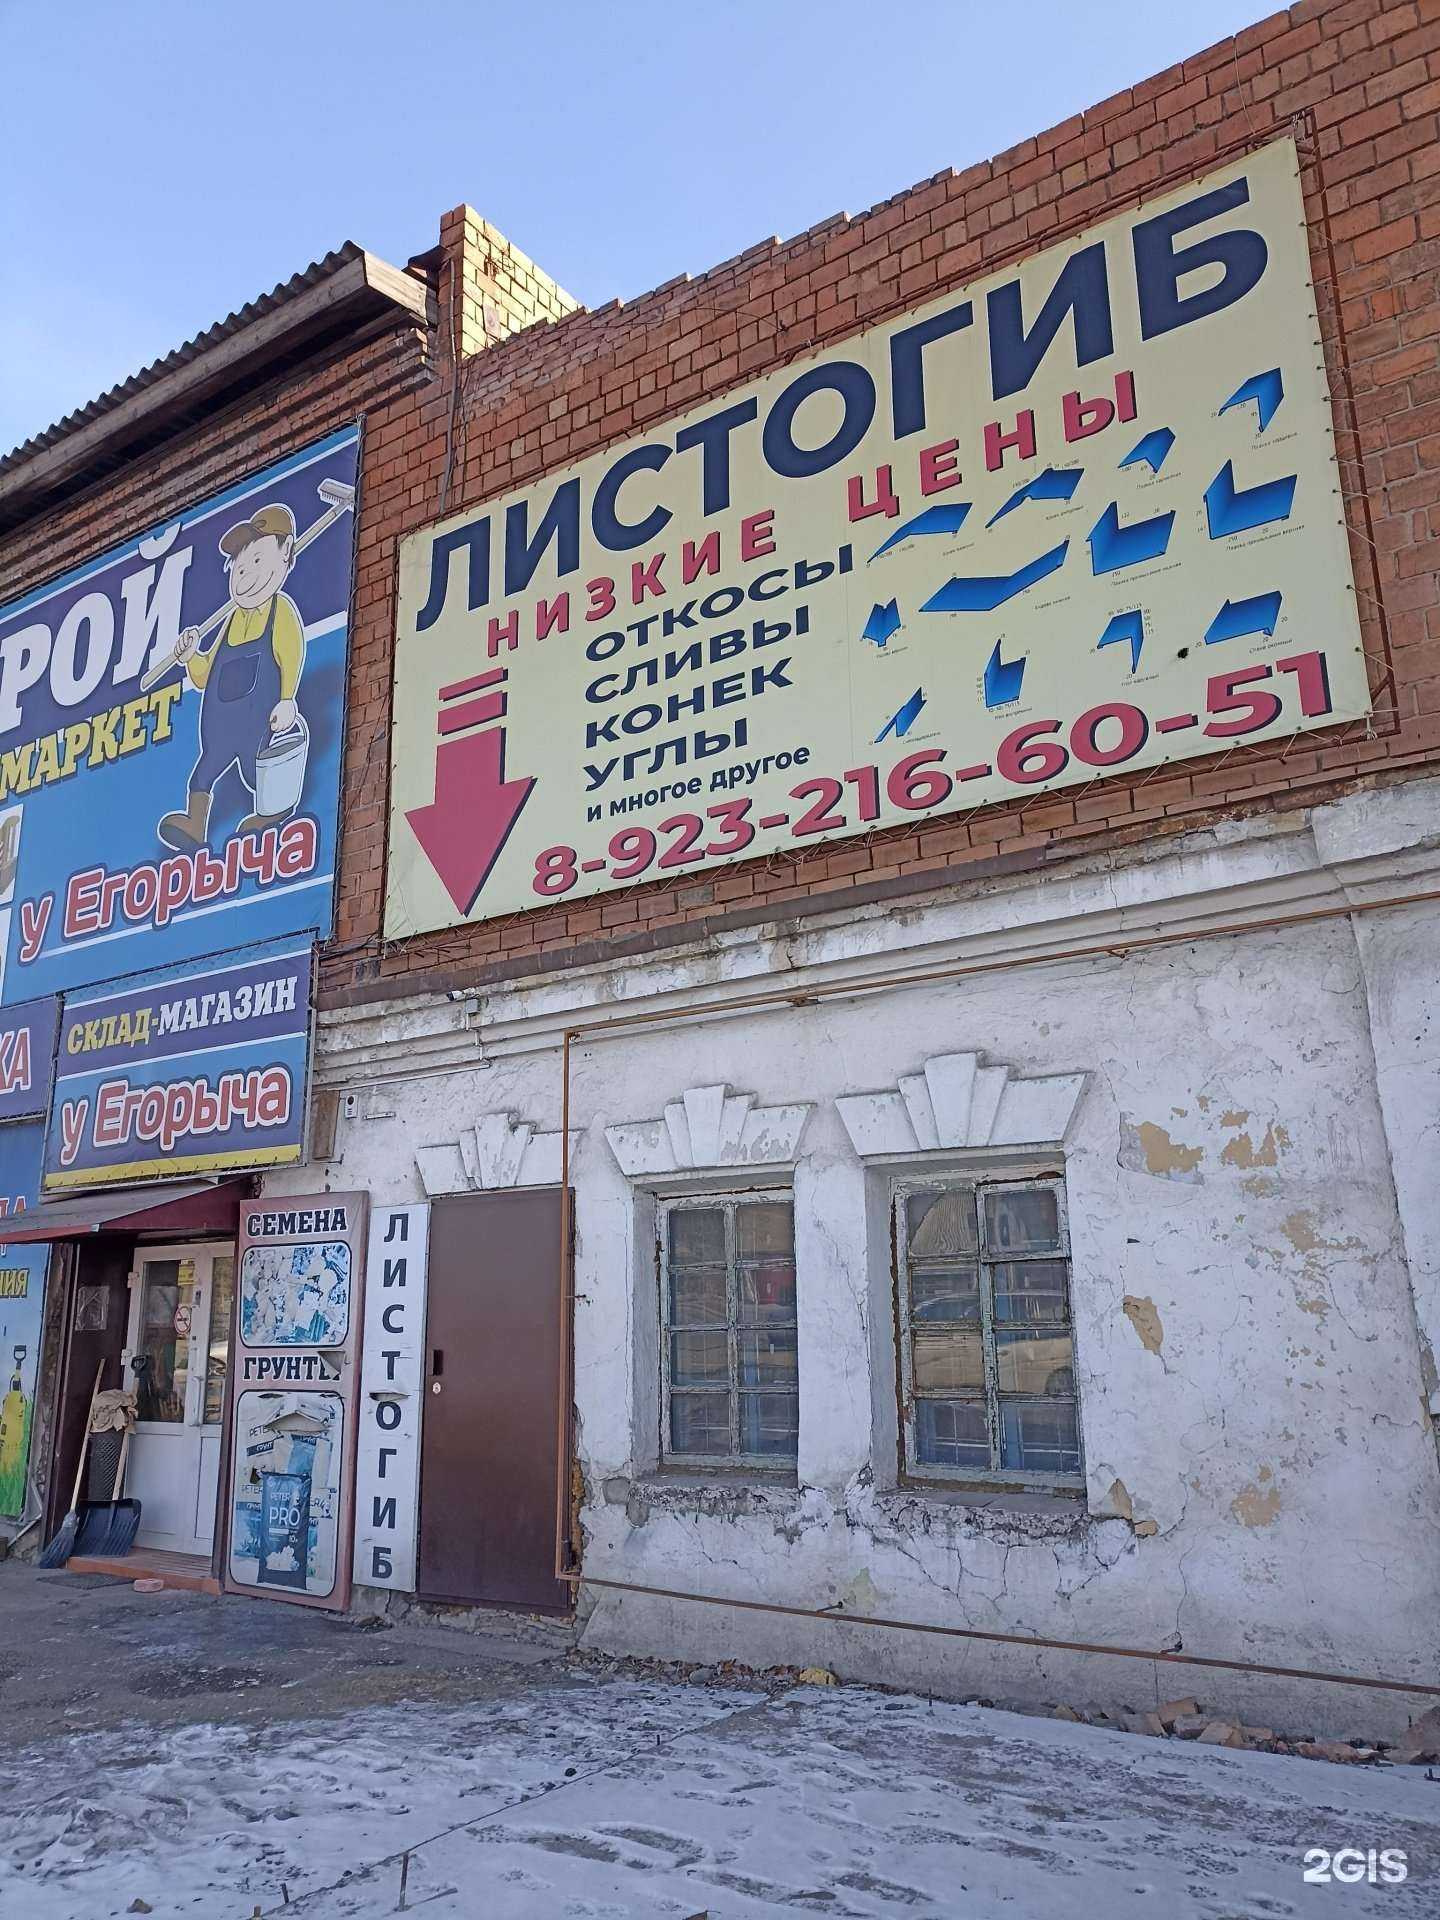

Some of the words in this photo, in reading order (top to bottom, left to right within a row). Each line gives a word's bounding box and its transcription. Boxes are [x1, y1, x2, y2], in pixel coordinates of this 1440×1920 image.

[415, 176, 1269, 632] ЛИСТОГИБ
[487, 510, 777, 658] НИЗКИЕ
[847, 370, 1138, 522] ЦЕНЫ
[0, 522, 194, 733] РОЙ
[585, 543, 854, 662] ОТКОСЫ
[585, 606, 810, 704] СЛИВЫ
[0, 683, 183, 800] МАРКЕТ
[584, 717, 748, 792] УГЛЫ
[585, 657, 794, 748] КОНЕК
[532, 651, 1334, 896] 8-923-216-60-51
[587, 804, 602, 822] и
[609, 776, 702, 816] многое
[709, 746, 811, 792] другое
[64, 819, 318, 938] Егорыча
[66, 976, 299, 1055] СКЛАД-МАГАЗИН
[93, 1067, 291, 1151] Егорыча
[246, 1207, 349, 1238] СЕМЕНА
[370, 1213, 410, 1580] ЛИСТОГИБ
[269, 1506, 300, 1527] PRO
